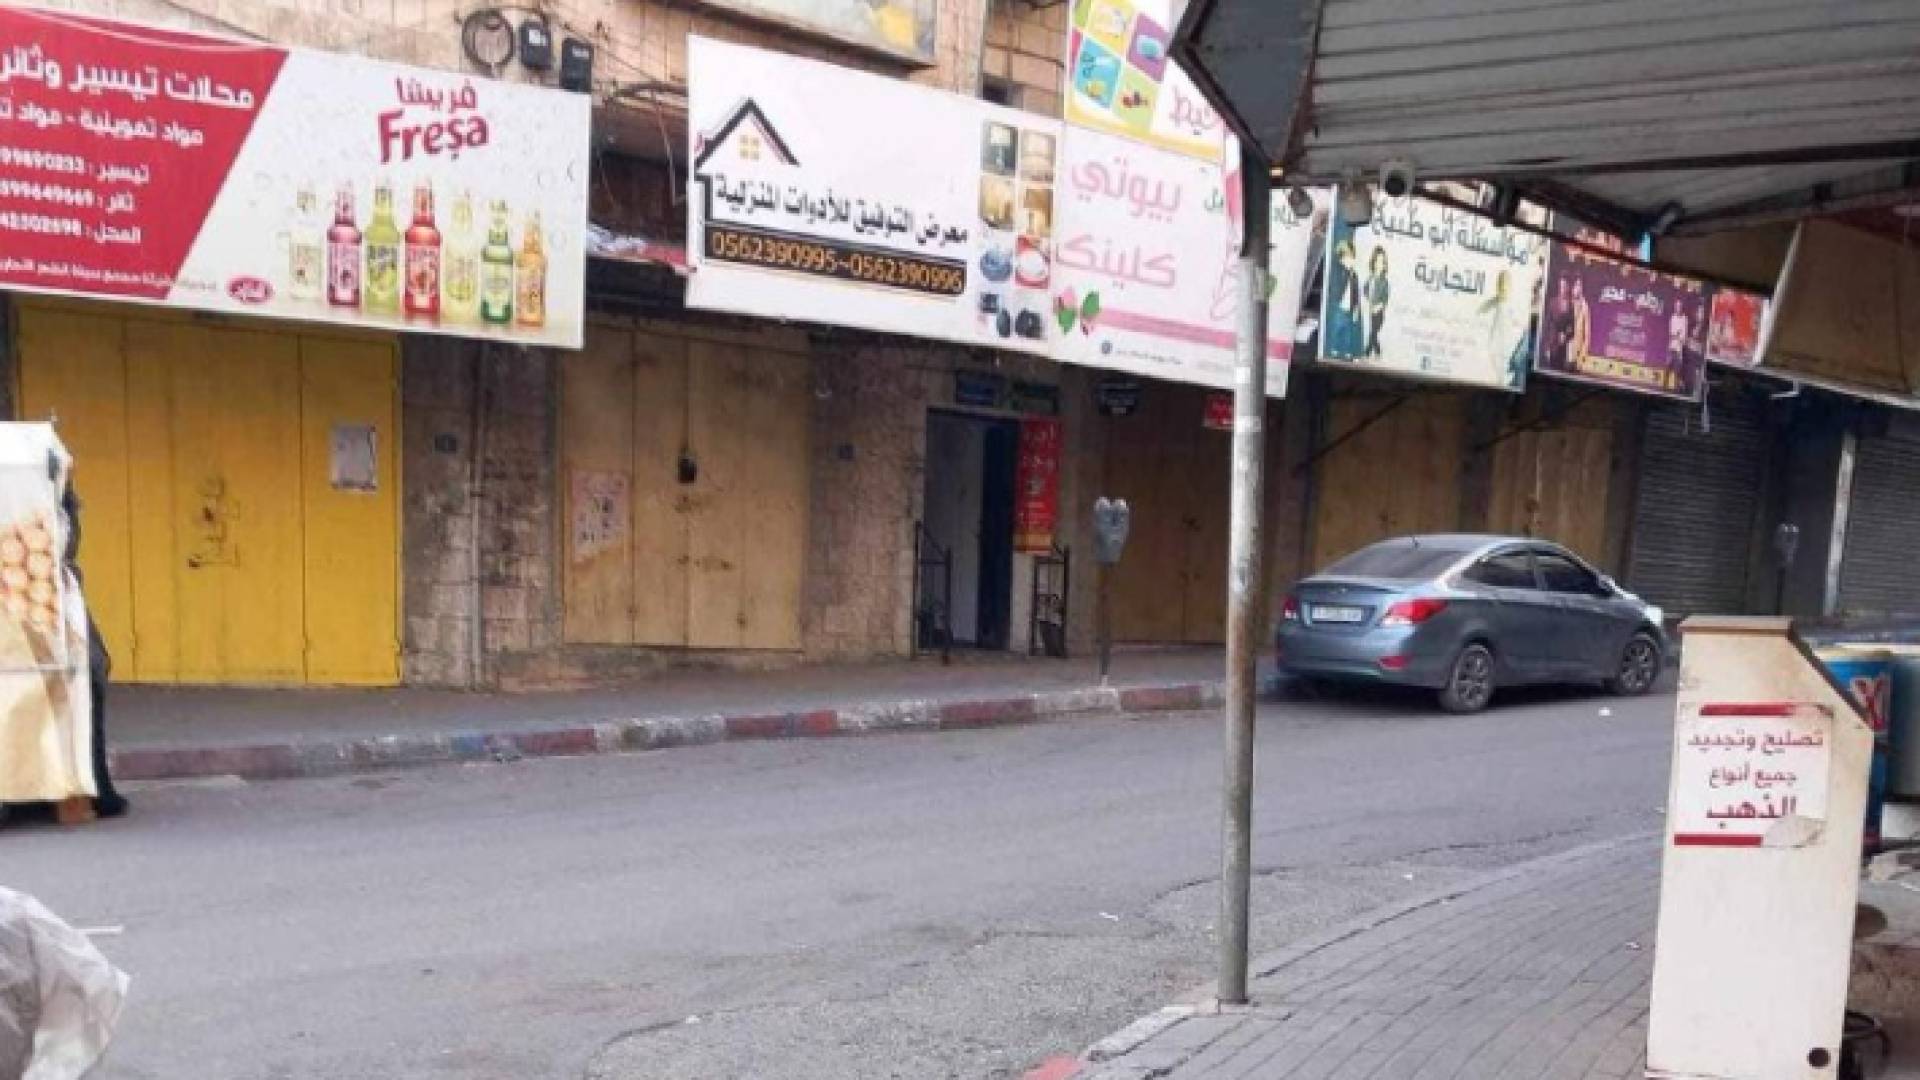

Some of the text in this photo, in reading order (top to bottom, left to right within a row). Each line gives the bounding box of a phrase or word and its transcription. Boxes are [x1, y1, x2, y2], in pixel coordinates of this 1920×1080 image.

[69, 64, 158, 102] تيسير
[165, 73, 254, 110] محلات
[396, 77, 477, 112] فريشا
[19, 102, 62, 128] مواد
[81, 110, 157, 139] تموينية
[162, 121, 204, 148] مواد
[1072, 155, 1181, 223] بيوتي
[715, 173, 968, 247] معرض التوفيق للأدوات المنزلية
[94, 221, 141, 244] المحل
[1054, 233, 1176, 288] كلينك
[1414, 255, 1486, 295] التجارية
[1687, 728, 1824, 756] تصليح وتجديد
[1708, 761, 1798, 790] جميع أنواع
[1706, 794, 1798, 829] الذهب
